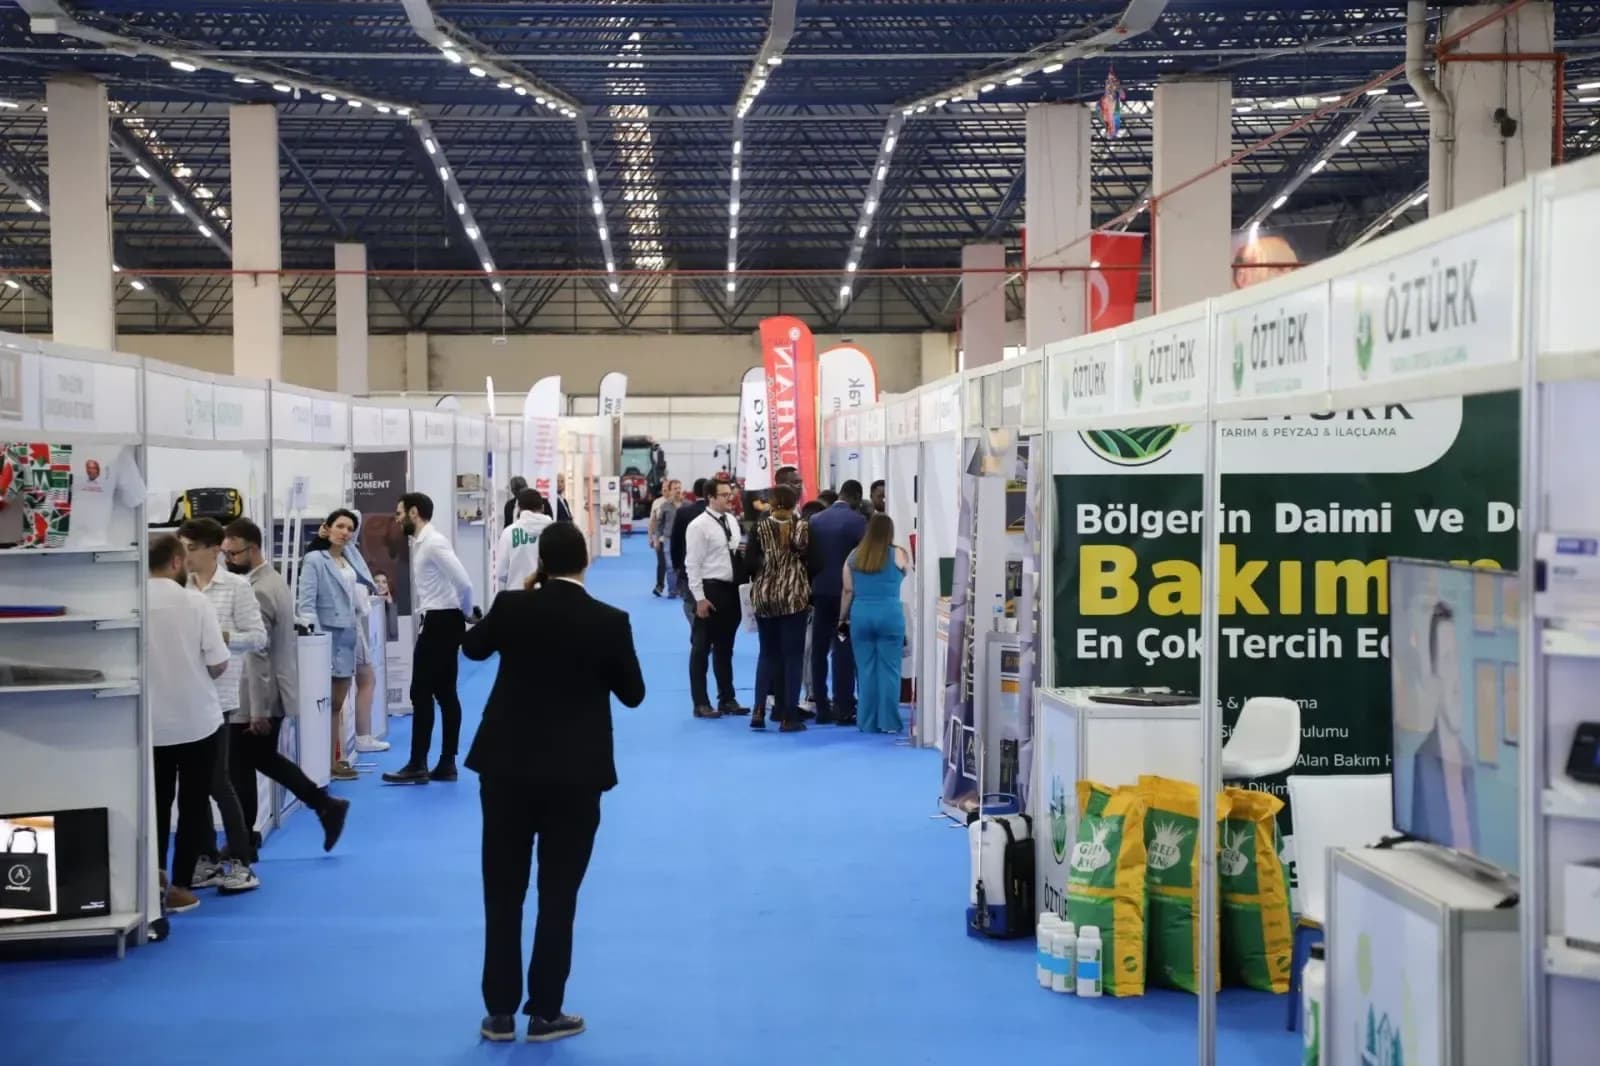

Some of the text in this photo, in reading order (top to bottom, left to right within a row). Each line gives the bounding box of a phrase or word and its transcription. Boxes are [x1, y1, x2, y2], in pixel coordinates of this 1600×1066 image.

[1384, 257, 1477, 343] ÖZTÜRK
[1148, 329, 1195, 385] ÖZTÜRK
[1251, 307, 1308, 370] ÖZTÜRK
[1072, 360, 1107, 399] ÖZTÜRK
[1221, 427, 1257, 438] TARIM
[1273, 427, 1319, 438] PEYZAJ
[1275, 502, 1392, 533] Daimi
[1414, 508, 1465, 533] ve
[1487, 501, 1521, 533] D
[1079, 543, 1503, 617] Bakım
[1077, 628, 1123, 659] En
[1137, 627, 1203, 666] Çok
[1222, 627, 1342, 659] Tercih
[1296, 753, 1329, 767] Alan
[1334, 753, 1380, 767] Bakım
